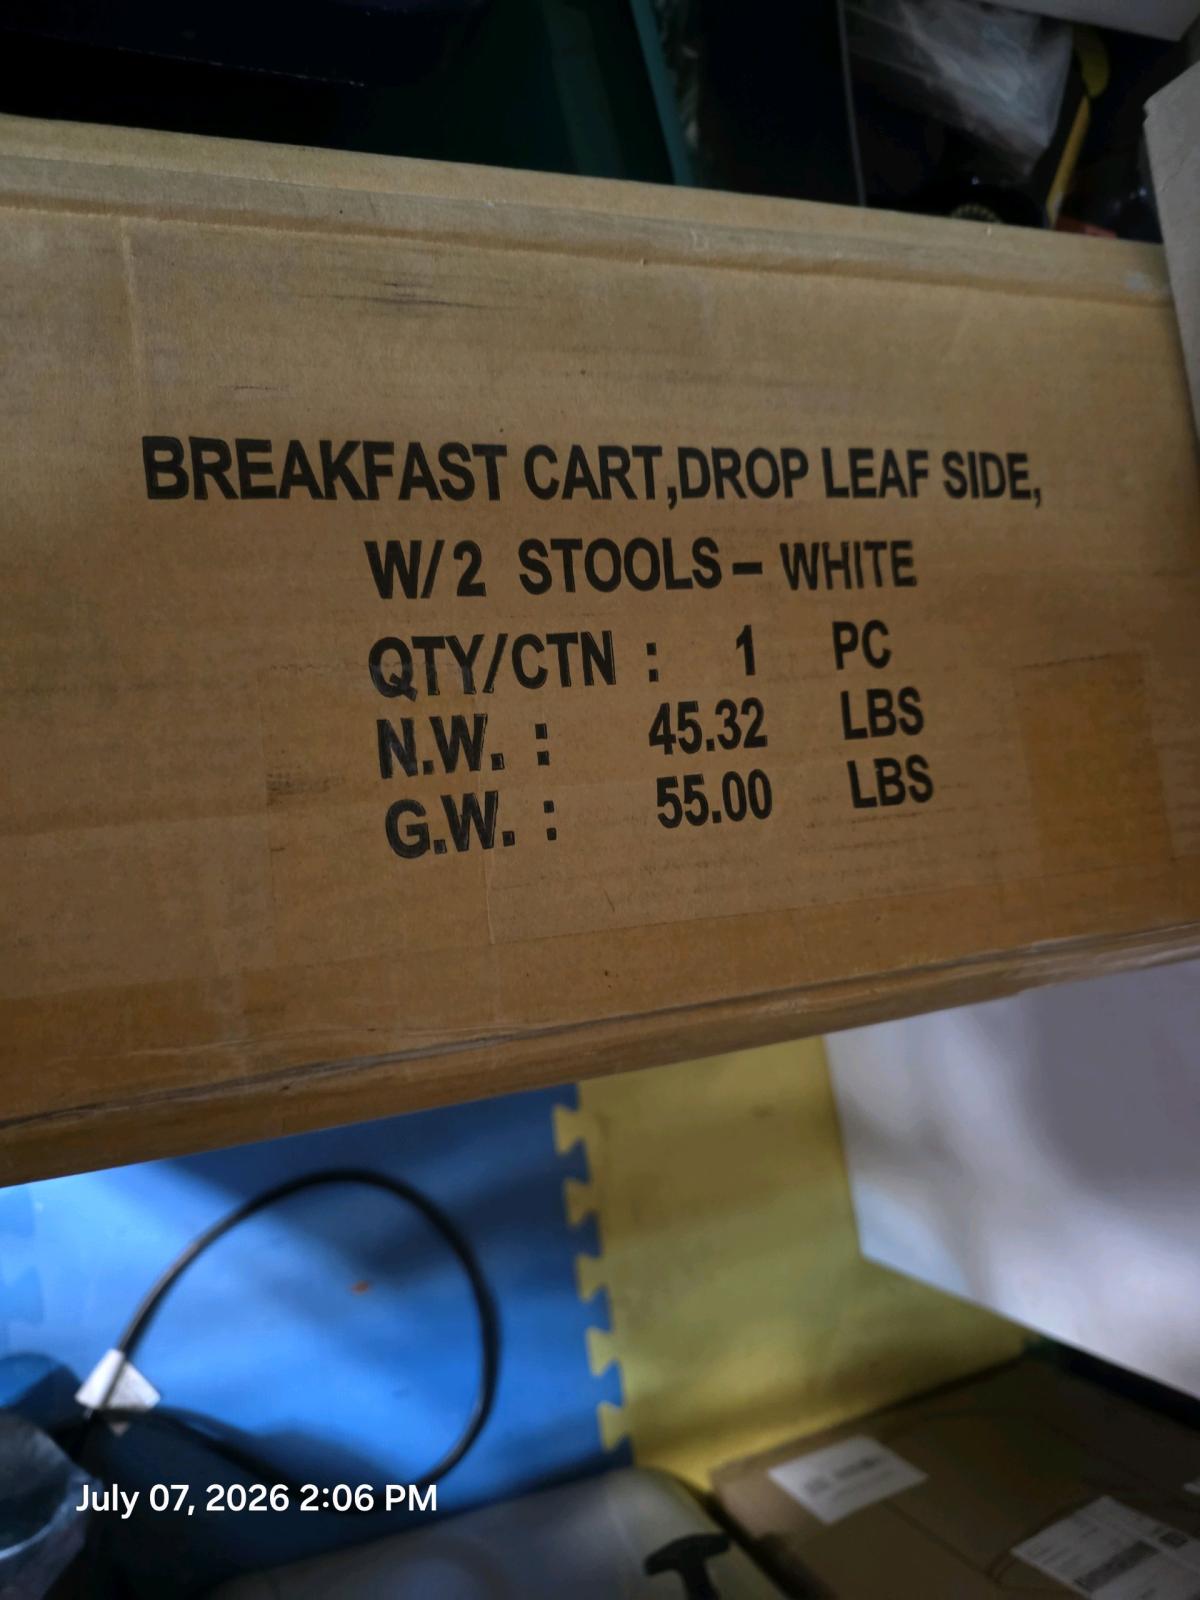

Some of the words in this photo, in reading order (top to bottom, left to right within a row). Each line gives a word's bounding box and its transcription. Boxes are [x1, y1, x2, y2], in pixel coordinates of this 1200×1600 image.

[142, 436, 508, 501] BREAKFAST
[822, 448, 928, 499] LEAF
[942, 450, 1042, 508] SIDE,
[779, 540, 918, 591] WHITE
[368, 630, 616, 702] QTY/CTN
[729, 624, 756, 676] 1
[832, 619, 892, 670] PC
[376, 713, 505, 779] N.W.
[648, 697, 768, 755] 45.32
[841, 686, 924, 740] LBS
[385, 790, 516, 859] G.W.
[657, 769, 773, 828] 55.00
[847, 754, 934, 808] LBS
